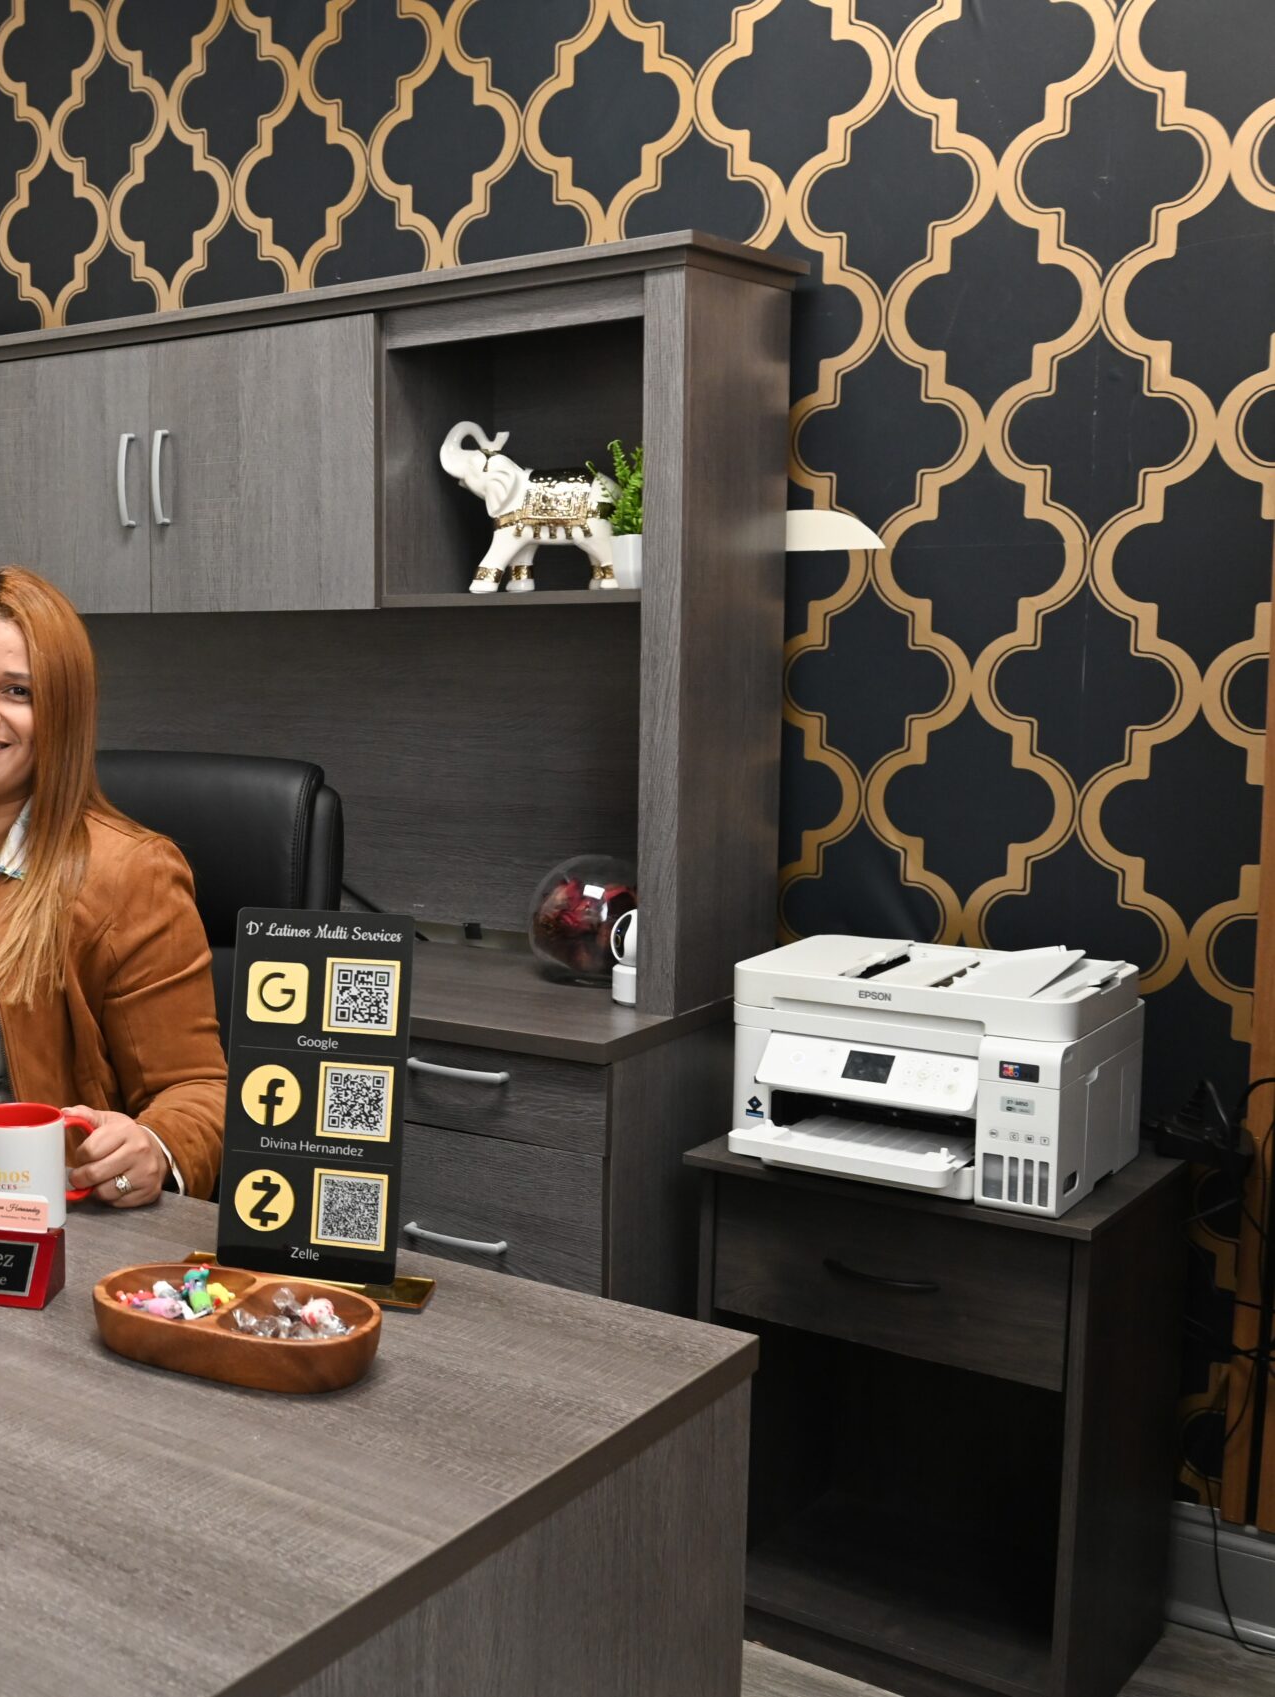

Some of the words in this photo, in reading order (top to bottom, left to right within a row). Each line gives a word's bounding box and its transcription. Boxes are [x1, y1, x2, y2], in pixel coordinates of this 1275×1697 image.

[265, 922, 313, 938] Latinos
[314, 923, 350, 940] Multi
[351, 926, 403, 943] Services
[858, 990, 892, 1001] EPSON
[296, 1035, 339, 1051] Google
[259, 1136, 297, 1152] Divina
[298, 1140, 364, 1157] Hernandez
[290, 1245, 320, 1261] Zelle
